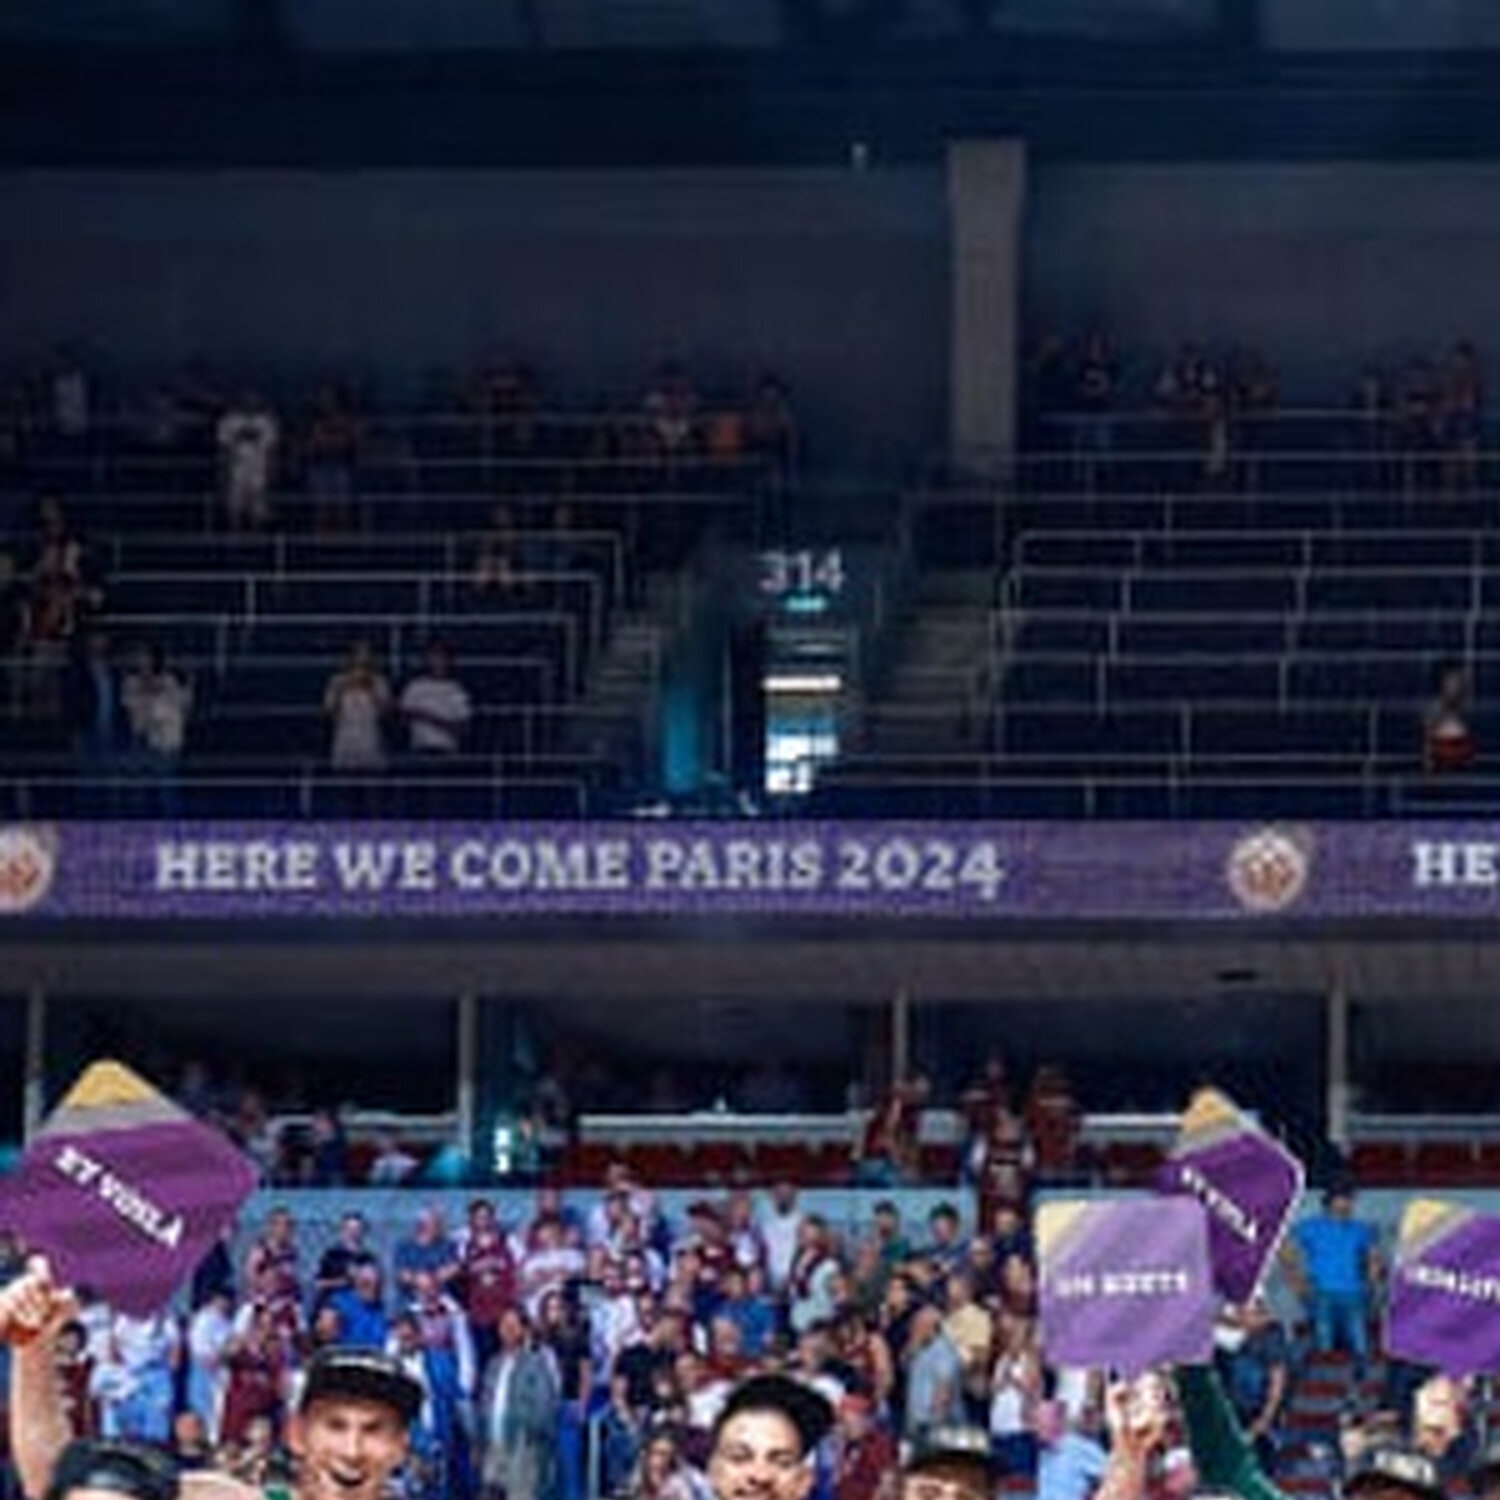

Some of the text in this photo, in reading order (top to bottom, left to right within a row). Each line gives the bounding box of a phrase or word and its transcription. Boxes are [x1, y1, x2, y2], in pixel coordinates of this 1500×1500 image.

[757, 550, 846, 591] 314
[157, 841, 1005, 899] HERE WE COME PARIS 2024
